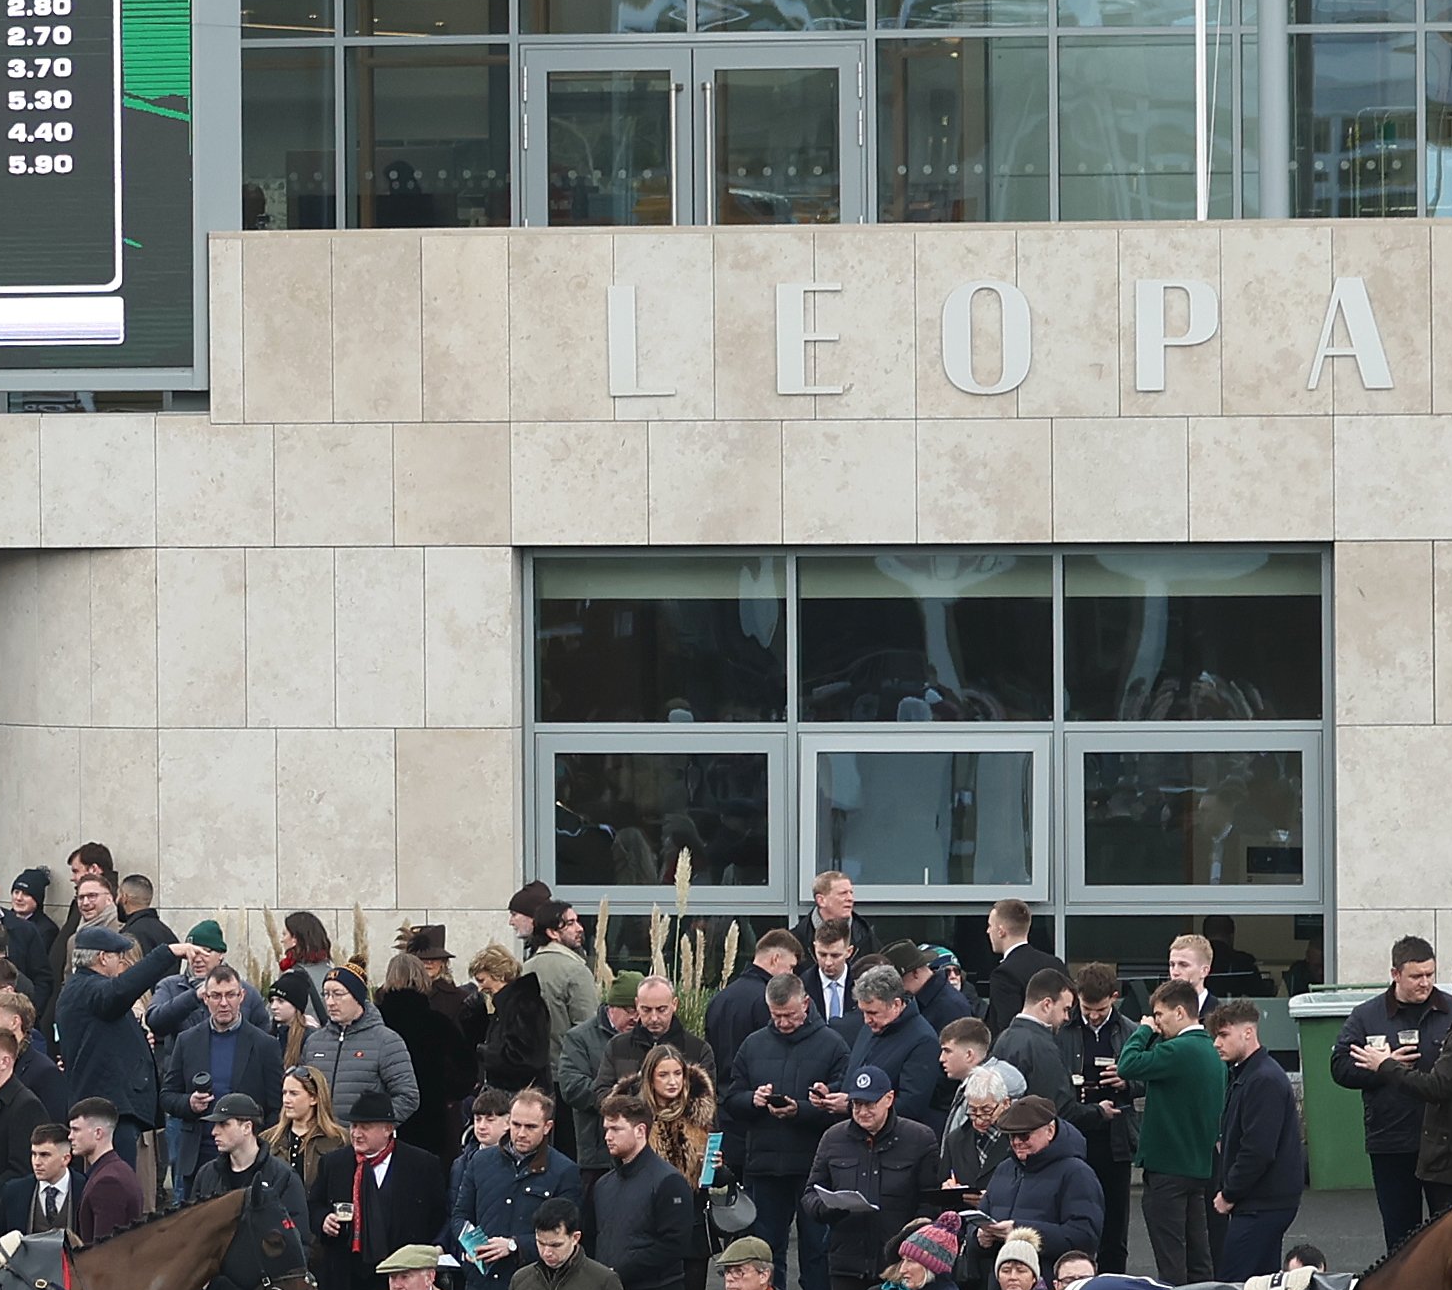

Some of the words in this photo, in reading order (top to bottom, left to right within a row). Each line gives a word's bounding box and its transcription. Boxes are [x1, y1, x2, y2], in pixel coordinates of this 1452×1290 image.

[8, 25, 72, 46] 2.70
[8, 57, 72, 78] 3.70
[8, 89, 73, 111] 5.30
[8, 121, 73, 143] 4.40
[9, 154, 73, 175] 5.90
